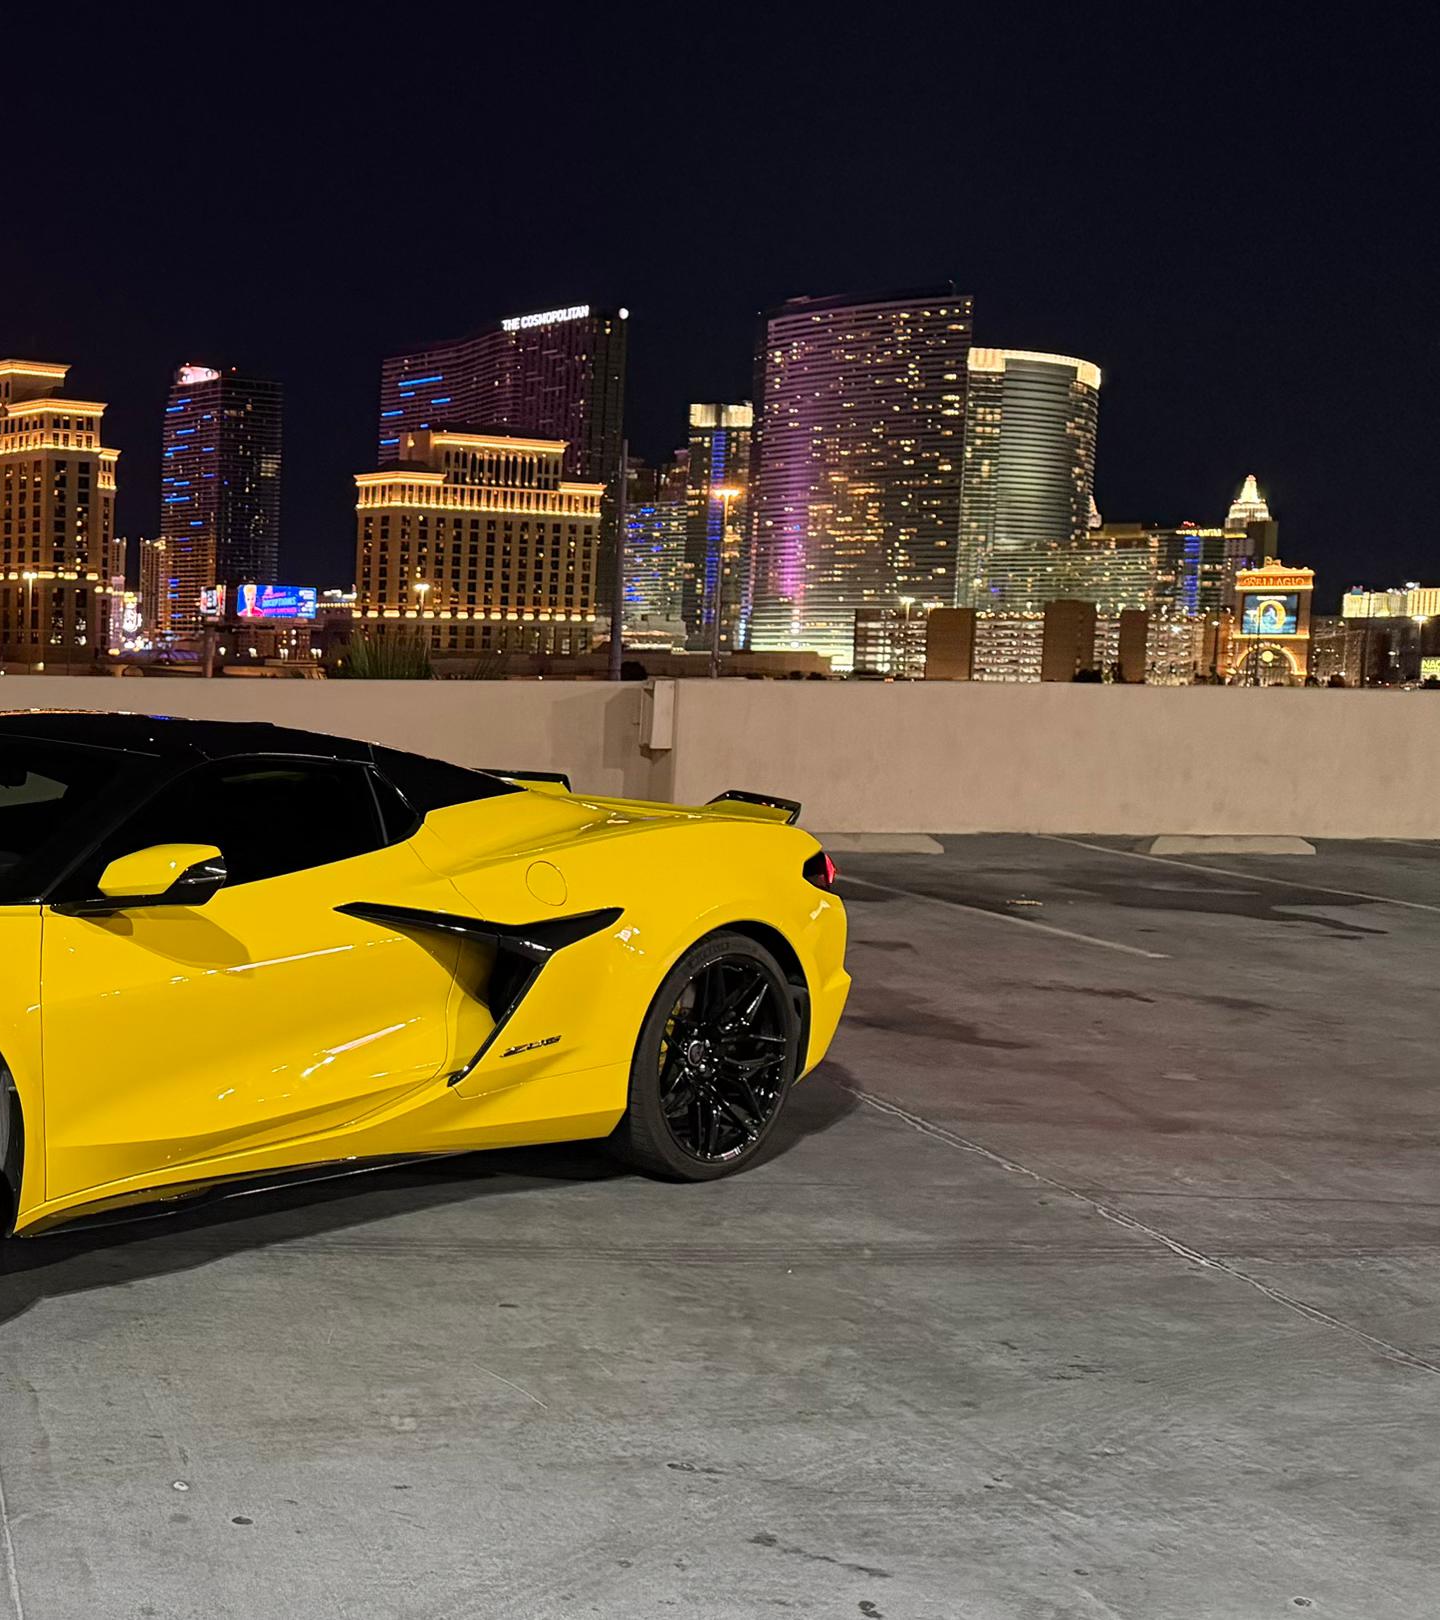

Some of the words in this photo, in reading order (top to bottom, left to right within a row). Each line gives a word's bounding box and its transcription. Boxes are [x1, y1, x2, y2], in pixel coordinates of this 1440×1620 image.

[501, 317, 521, 331] THE
[521, 305, 590, 328] COSMOPOLITAN
[1244, 576, 1305, 587] BELLAGIO
